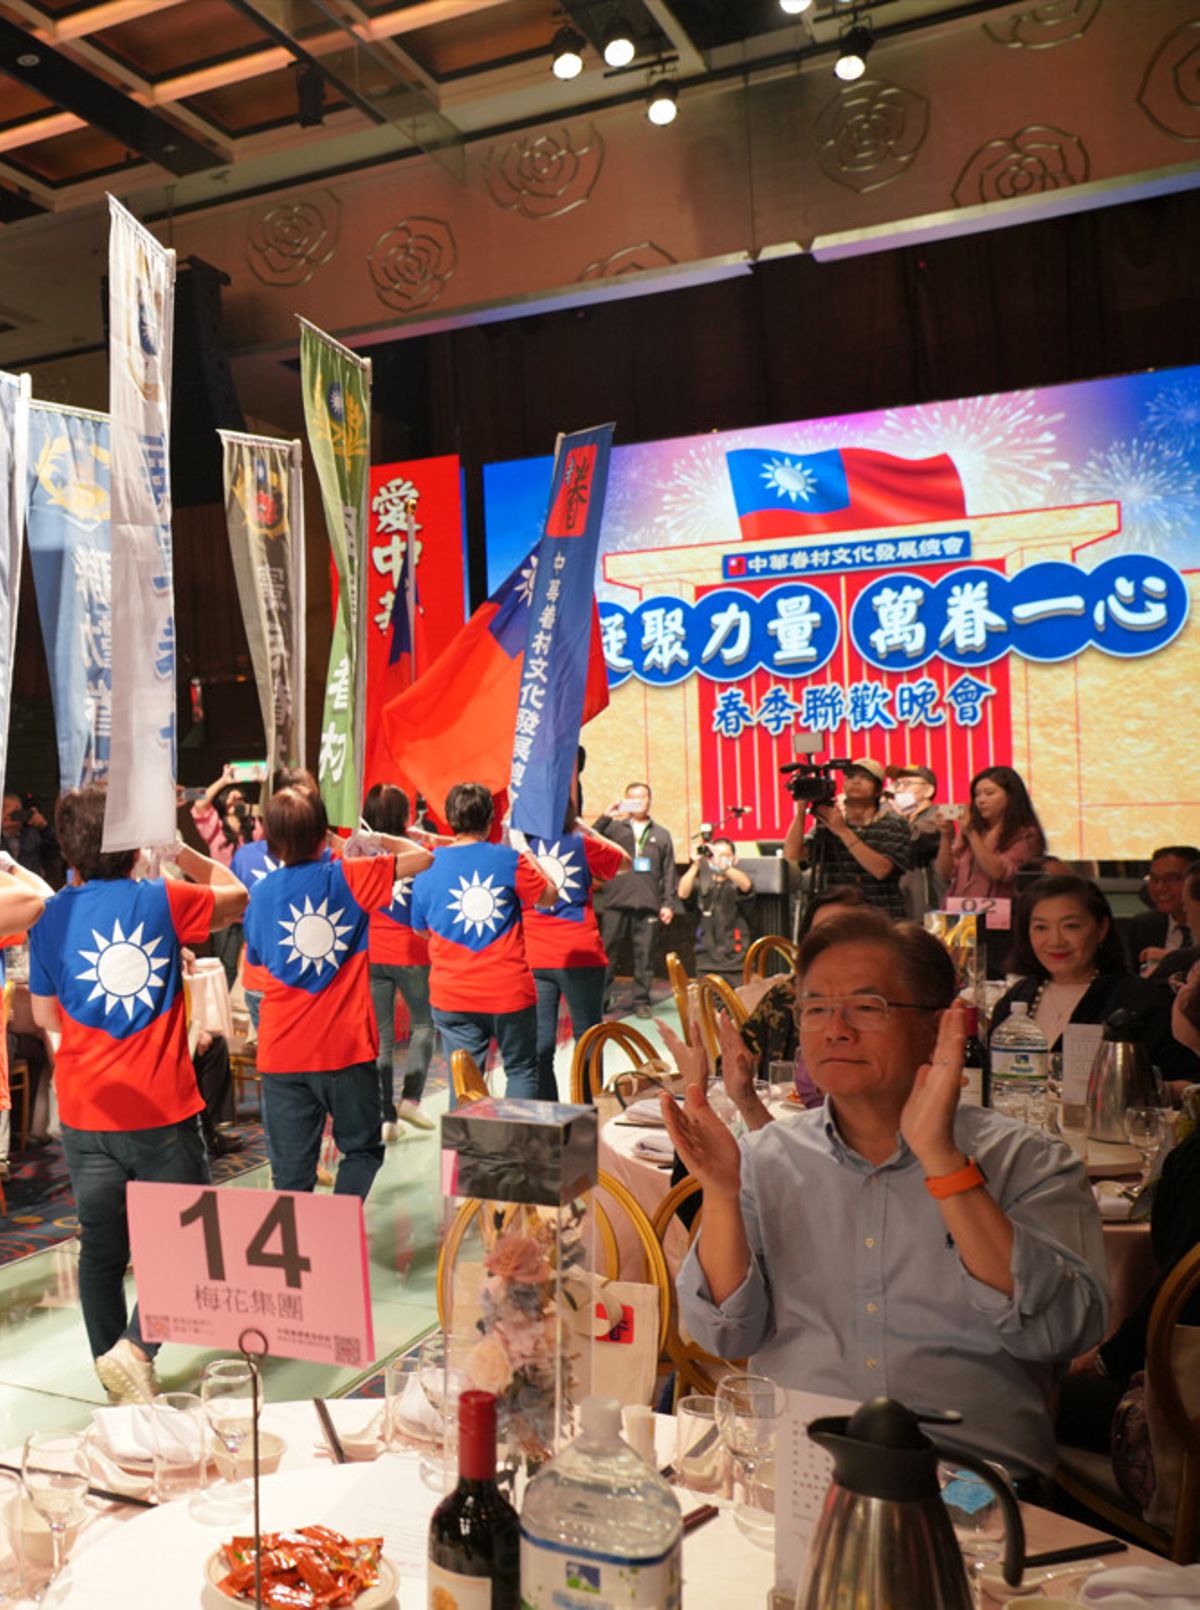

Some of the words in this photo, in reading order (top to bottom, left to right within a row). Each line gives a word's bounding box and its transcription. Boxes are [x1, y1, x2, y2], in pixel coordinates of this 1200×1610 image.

[748, 537, 964, 573] 中華眷村文化發展總會
[869, 576, 1166, 658] 萬眷一心
[714, 674, 995, 737] 春季聯歡晚會
[179, 1190, 311, 1289] 14
[194, 1285, 303, 1321] 梅花集團
